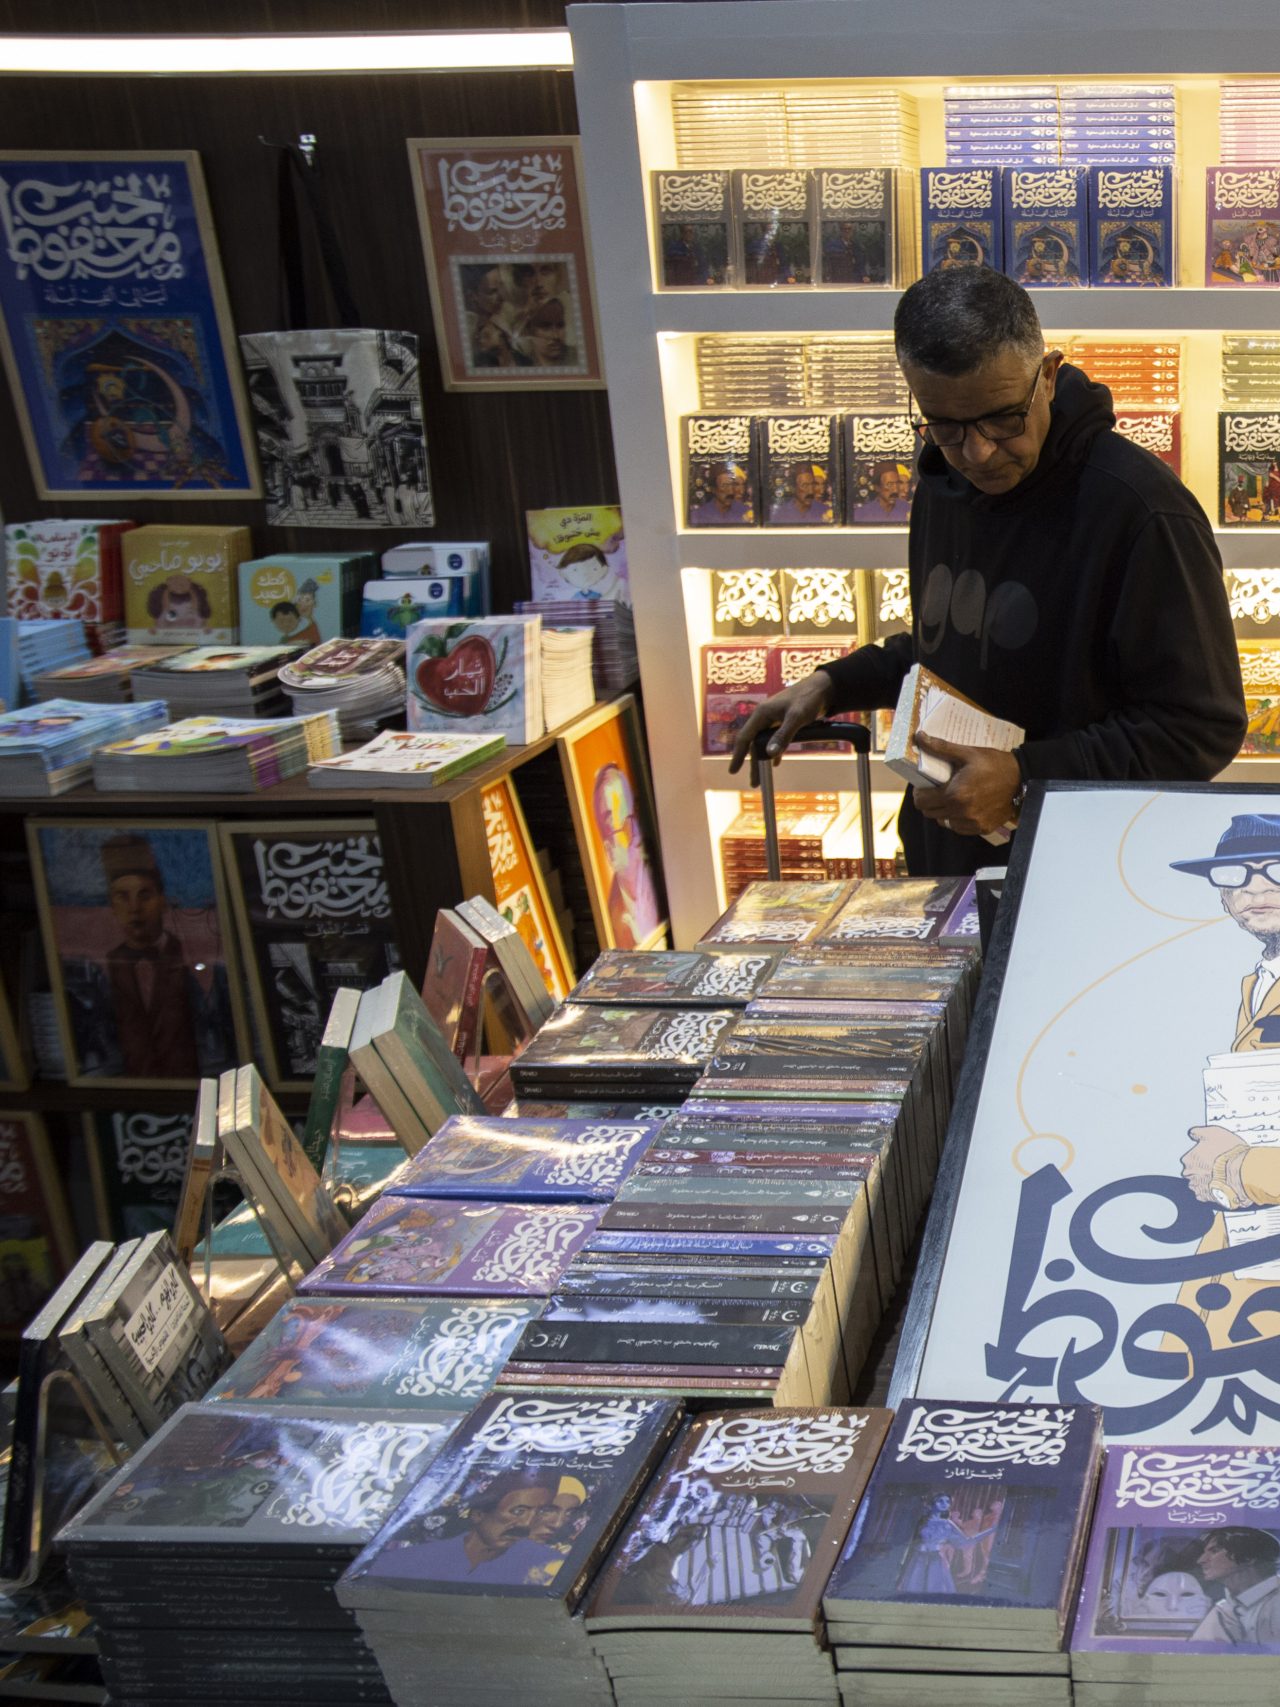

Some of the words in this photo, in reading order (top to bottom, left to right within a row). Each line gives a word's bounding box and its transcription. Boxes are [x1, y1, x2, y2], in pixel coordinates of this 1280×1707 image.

[719, 1414, 856, 1443] نجيب
[898, 1406, 1064, 1462] محفوظ
[924, 1409, 1064, 1436] نجيب
[689, 1416, 852, 1473] محفوظ
[1137, 1451, 1276, 1479] نجيب
[1115, 1451, 1280, 1508] محفوظ
